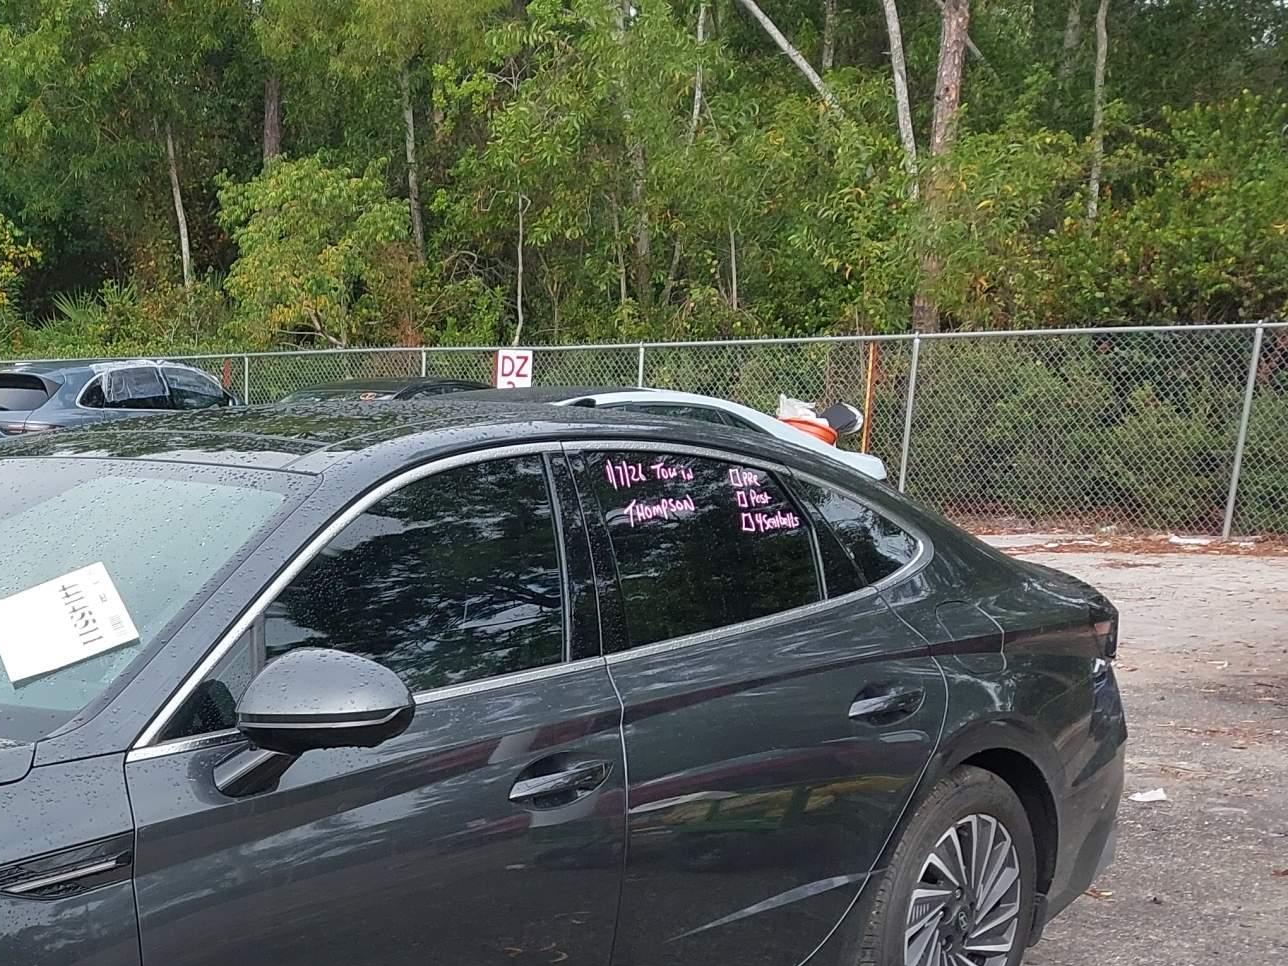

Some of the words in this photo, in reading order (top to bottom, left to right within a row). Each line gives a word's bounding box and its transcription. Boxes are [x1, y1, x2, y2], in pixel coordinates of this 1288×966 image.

[501, 355, 529, 378] DZ
[605, 459, 647, 490] 1/7/26
[650, 462, 678, 480] Tow
[58, 584, 104, 645] 44145511
